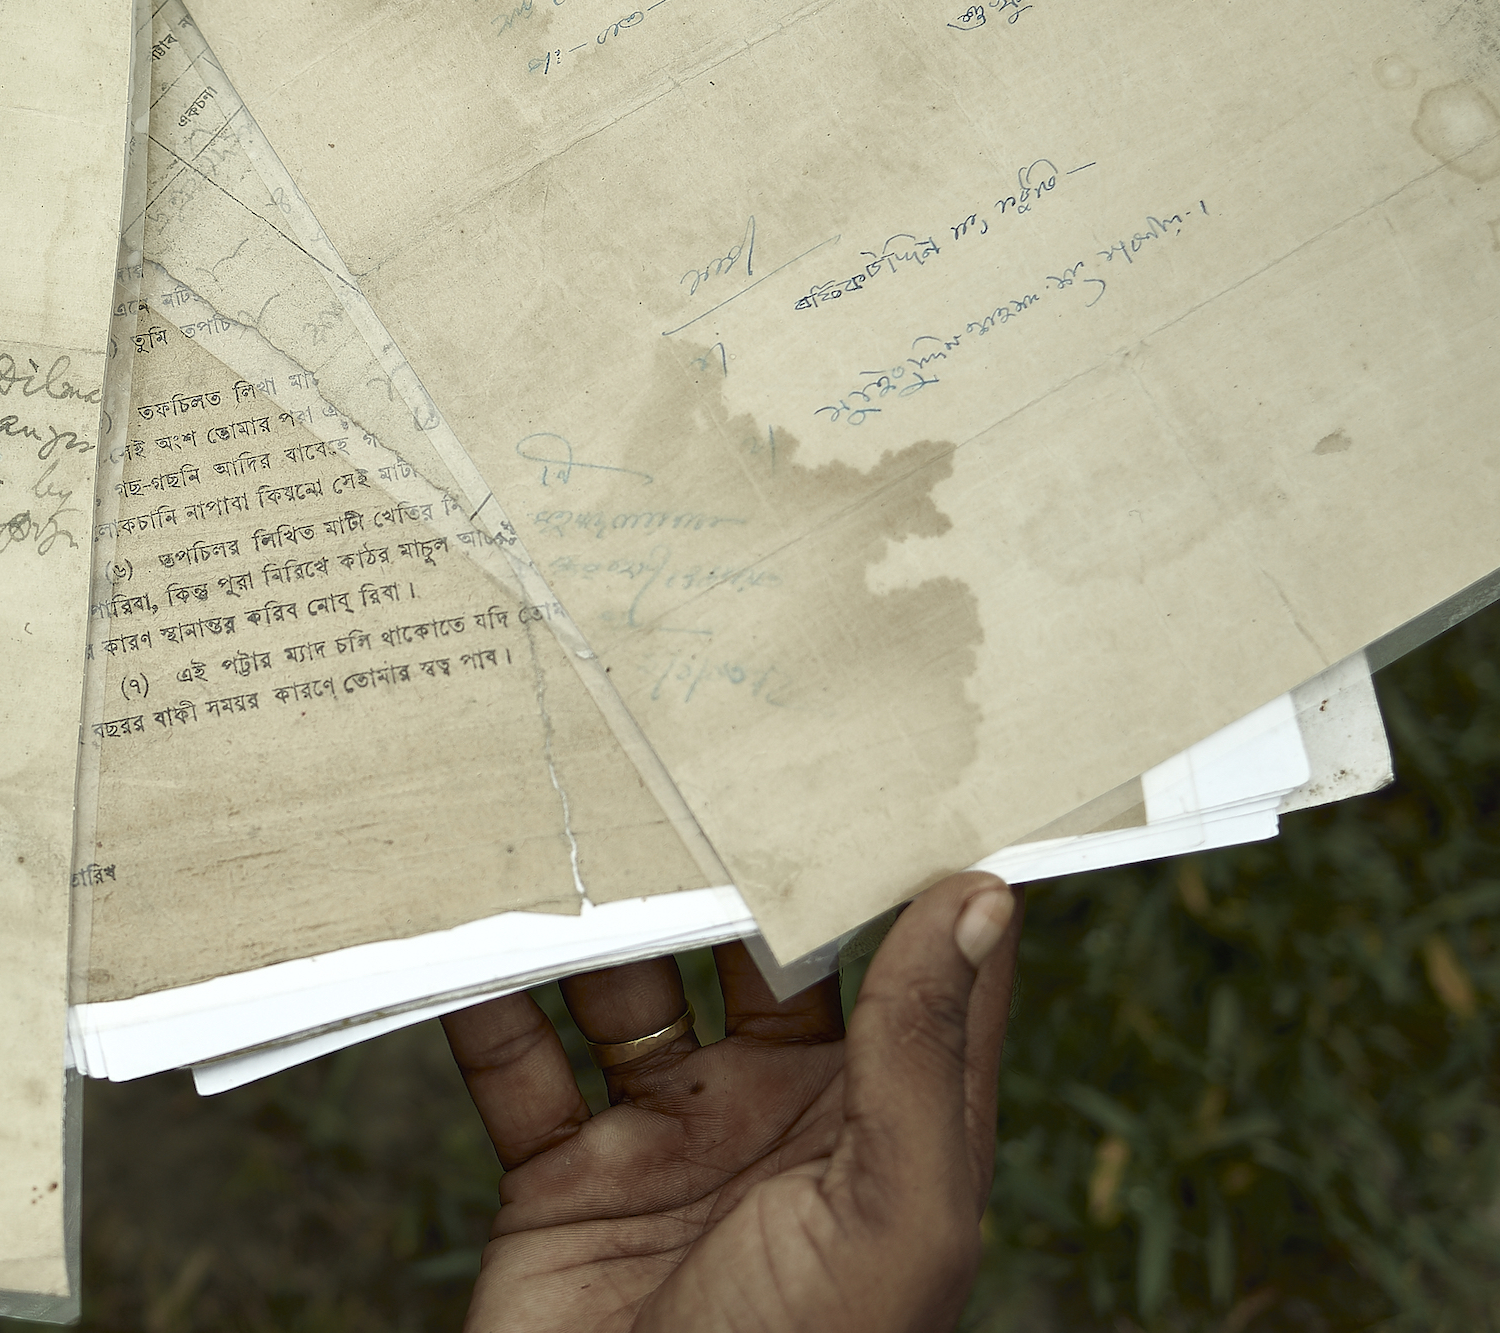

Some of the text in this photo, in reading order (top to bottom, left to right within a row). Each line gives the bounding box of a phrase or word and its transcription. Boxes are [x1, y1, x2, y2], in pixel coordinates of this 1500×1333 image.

[129, 312, 239, 355] তুমি তপচি
[136, 389, 222, 421] তফচিলত
[153, 429, 198, 452] অংশ
[250, 518, 316, 553] লিখিত
[175, 658, 209, 683] এই
[282, 640, 327, 664] ম্যাদ
[380, 615, 466, 648] থাকোতে
[472, 604, 510, 631] যদি
